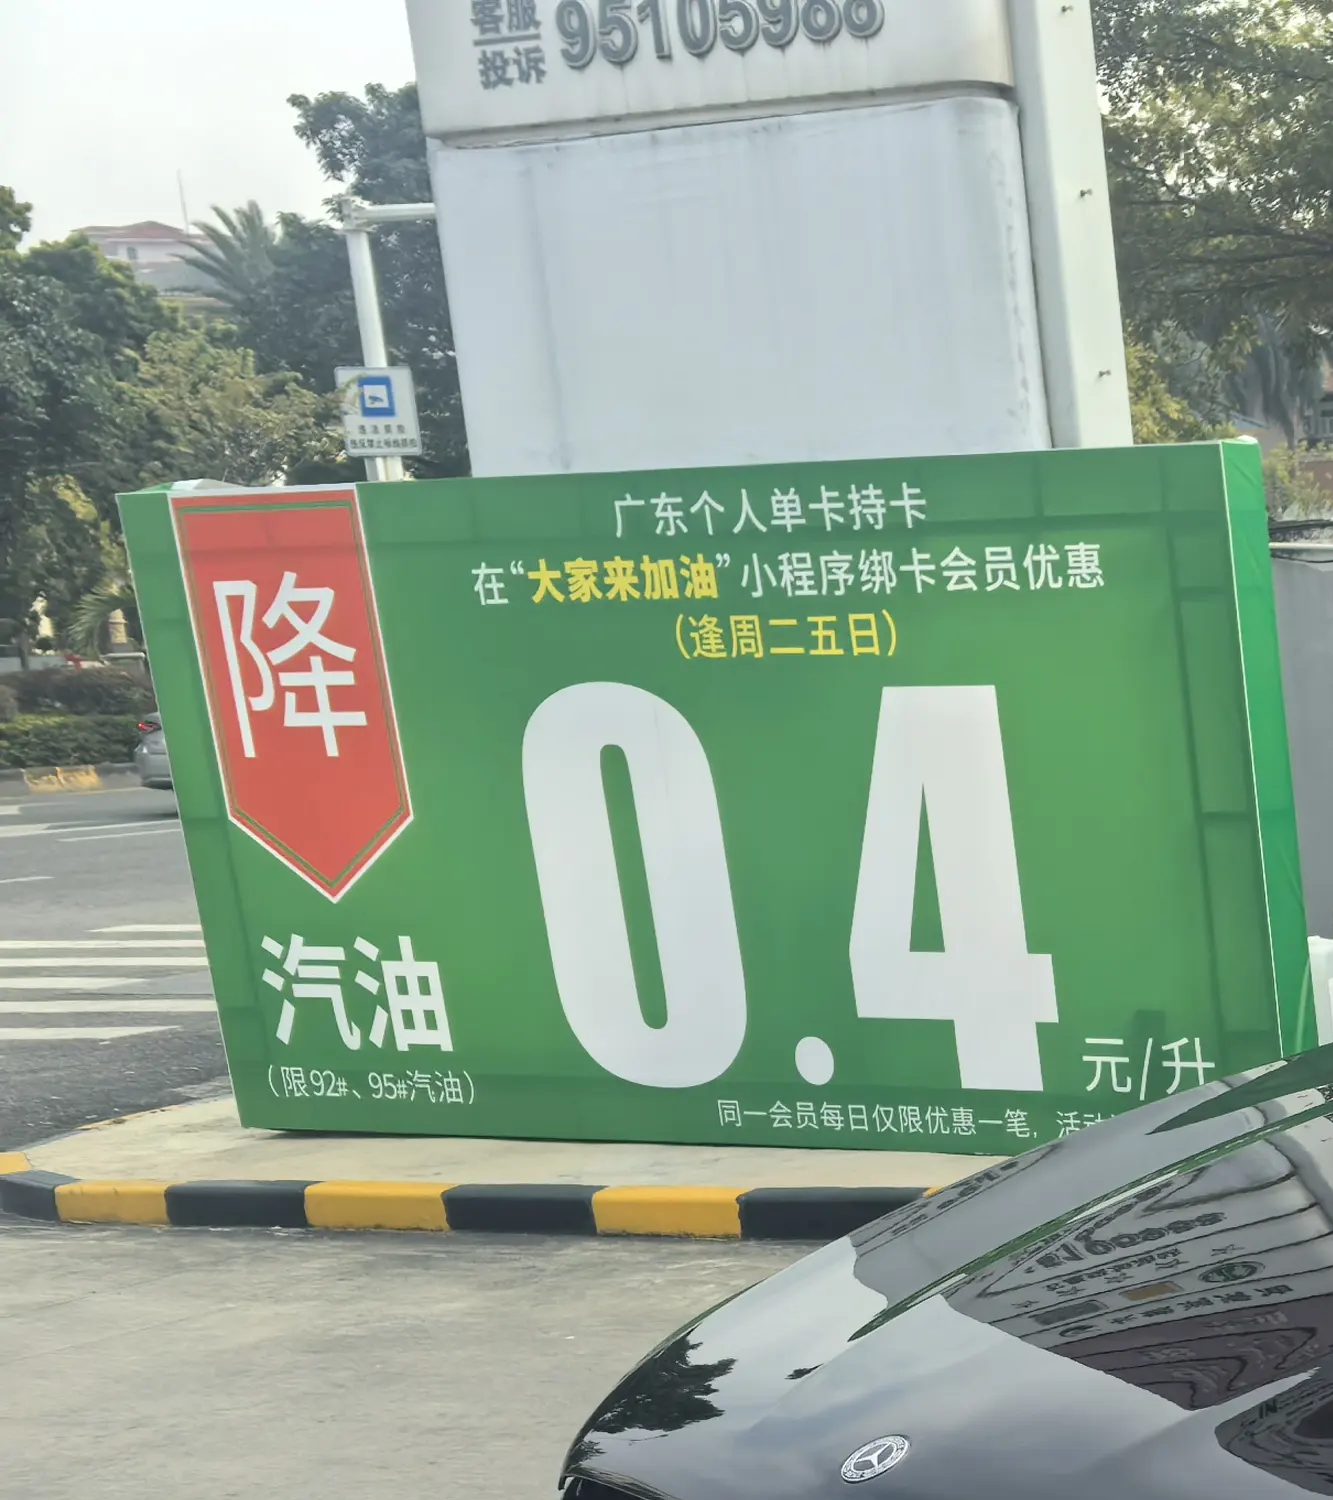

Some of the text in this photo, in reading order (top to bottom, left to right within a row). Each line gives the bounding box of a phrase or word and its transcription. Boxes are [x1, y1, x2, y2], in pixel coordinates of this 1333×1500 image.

[470, 0, 541, 35] 客服
[478, 45, 548, 90] 投诉
[613, 482, 927, 536] 广东个人单卡持卡
[212, 571, 368, 758] 降
[522, 681, 1060, 1092] 0.4
[261, 933, 454, 1052] 汽油
[1083, 1037, 1216, 1101] 元/升
